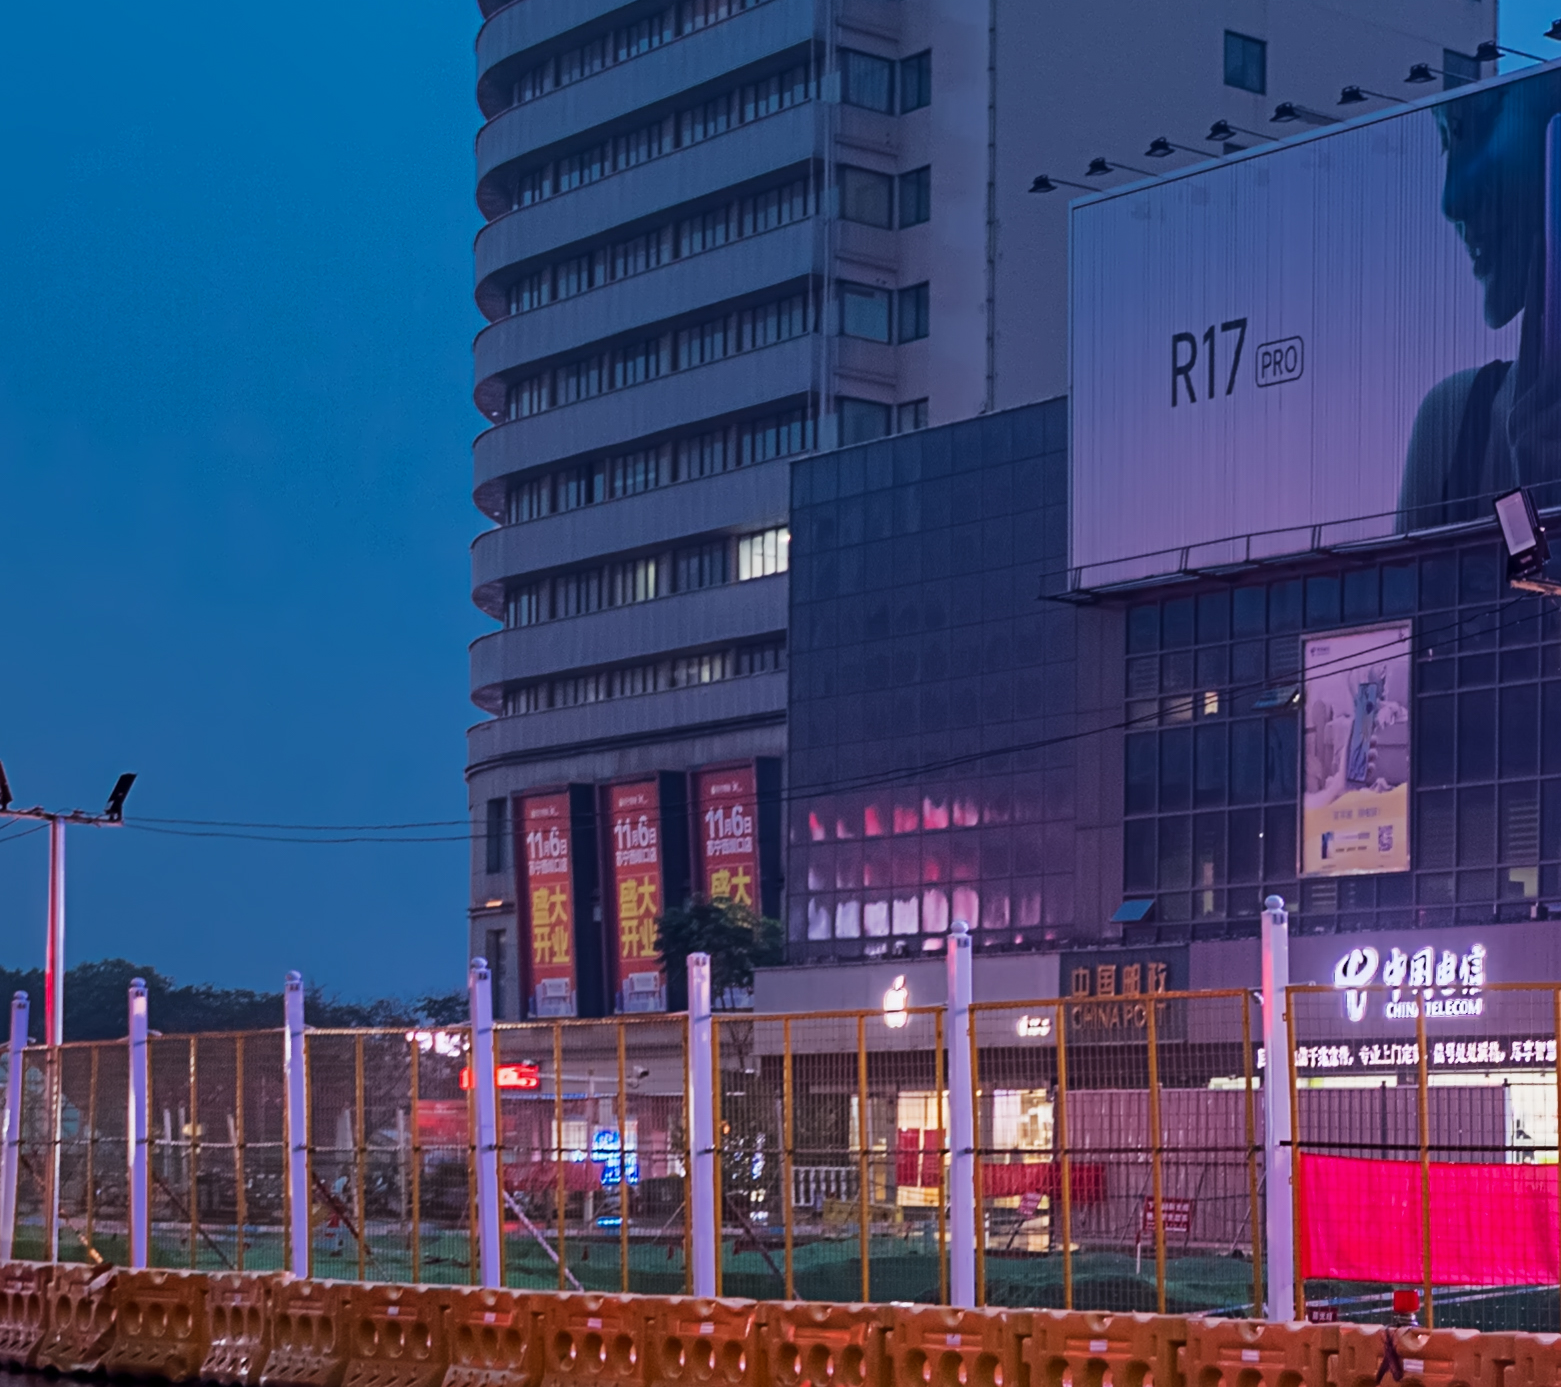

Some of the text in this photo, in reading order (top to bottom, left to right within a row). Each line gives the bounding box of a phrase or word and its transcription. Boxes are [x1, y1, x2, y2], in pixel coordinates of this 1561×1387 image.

[1170, 317, 1299, 409] R17 PRO
[533, 884, 568, 925] 盛大
[619, 876, 657, 919] 盛大
[710, 866, 752, 908] 盛大
[533, 925, 570, 965] 开业
[621, 918, 658, 958] 开业
[1071, 962, 1167, 996] 中国邮政
[1382, 943, 1487, 1001] 中国电信
[1071, 1004, 1118, 1029] CHINA
[1123, 1002, 1167, 1027] POT
[1425, 998, 1483, 1017] TELECOM
